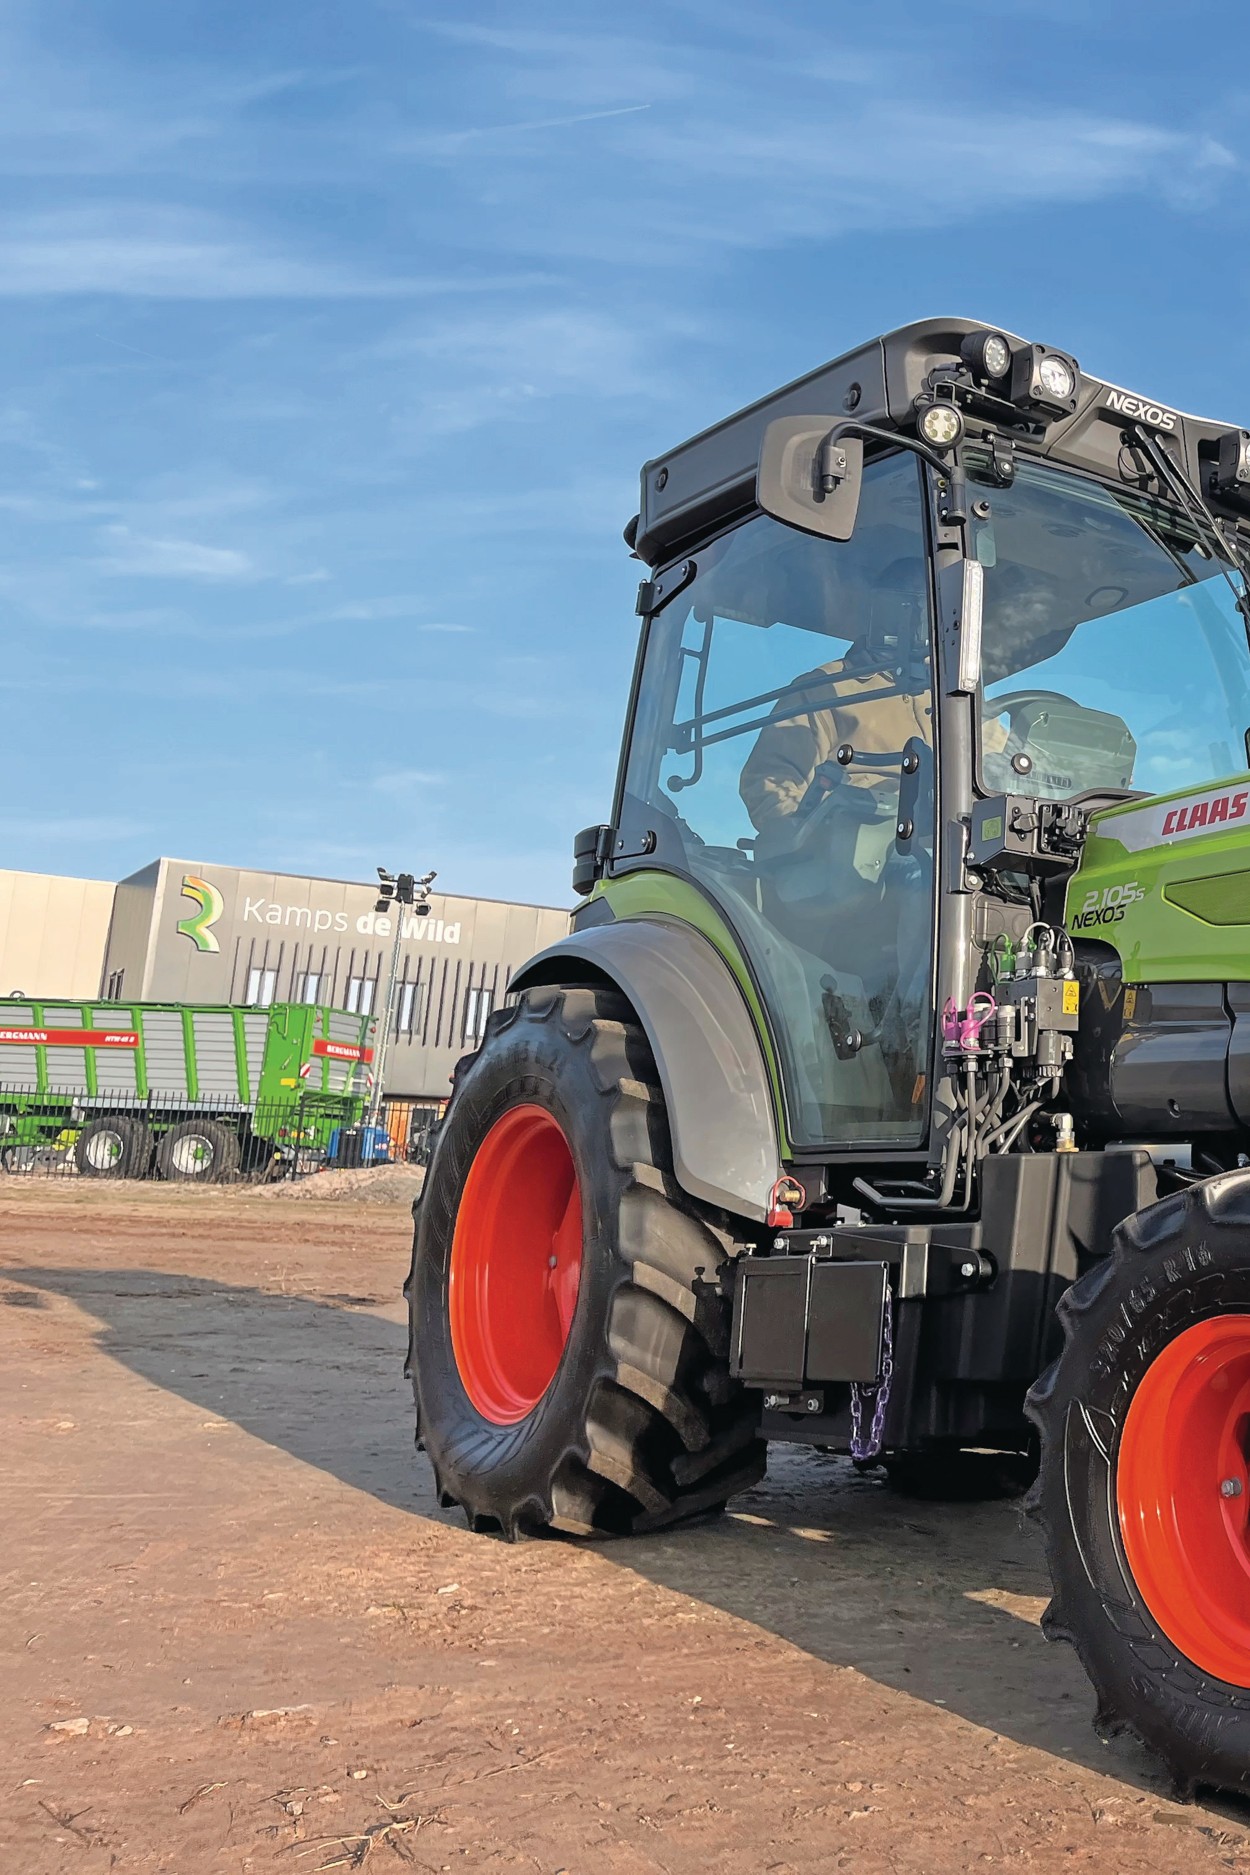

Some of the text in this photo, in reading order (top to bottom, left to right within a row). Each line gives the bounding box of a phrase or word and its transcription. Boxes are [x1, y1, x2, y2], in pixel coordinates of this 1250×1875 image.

[1105, 390, 1177, 430] NEXOS
[1161, 792, 1249, 836] CLAAS
[243, 897, 462, 945] Kamps de Wild
[1071, 904, 1127, 931] NEXOS
[0, 1031, 48, 1041] ERGMANN
